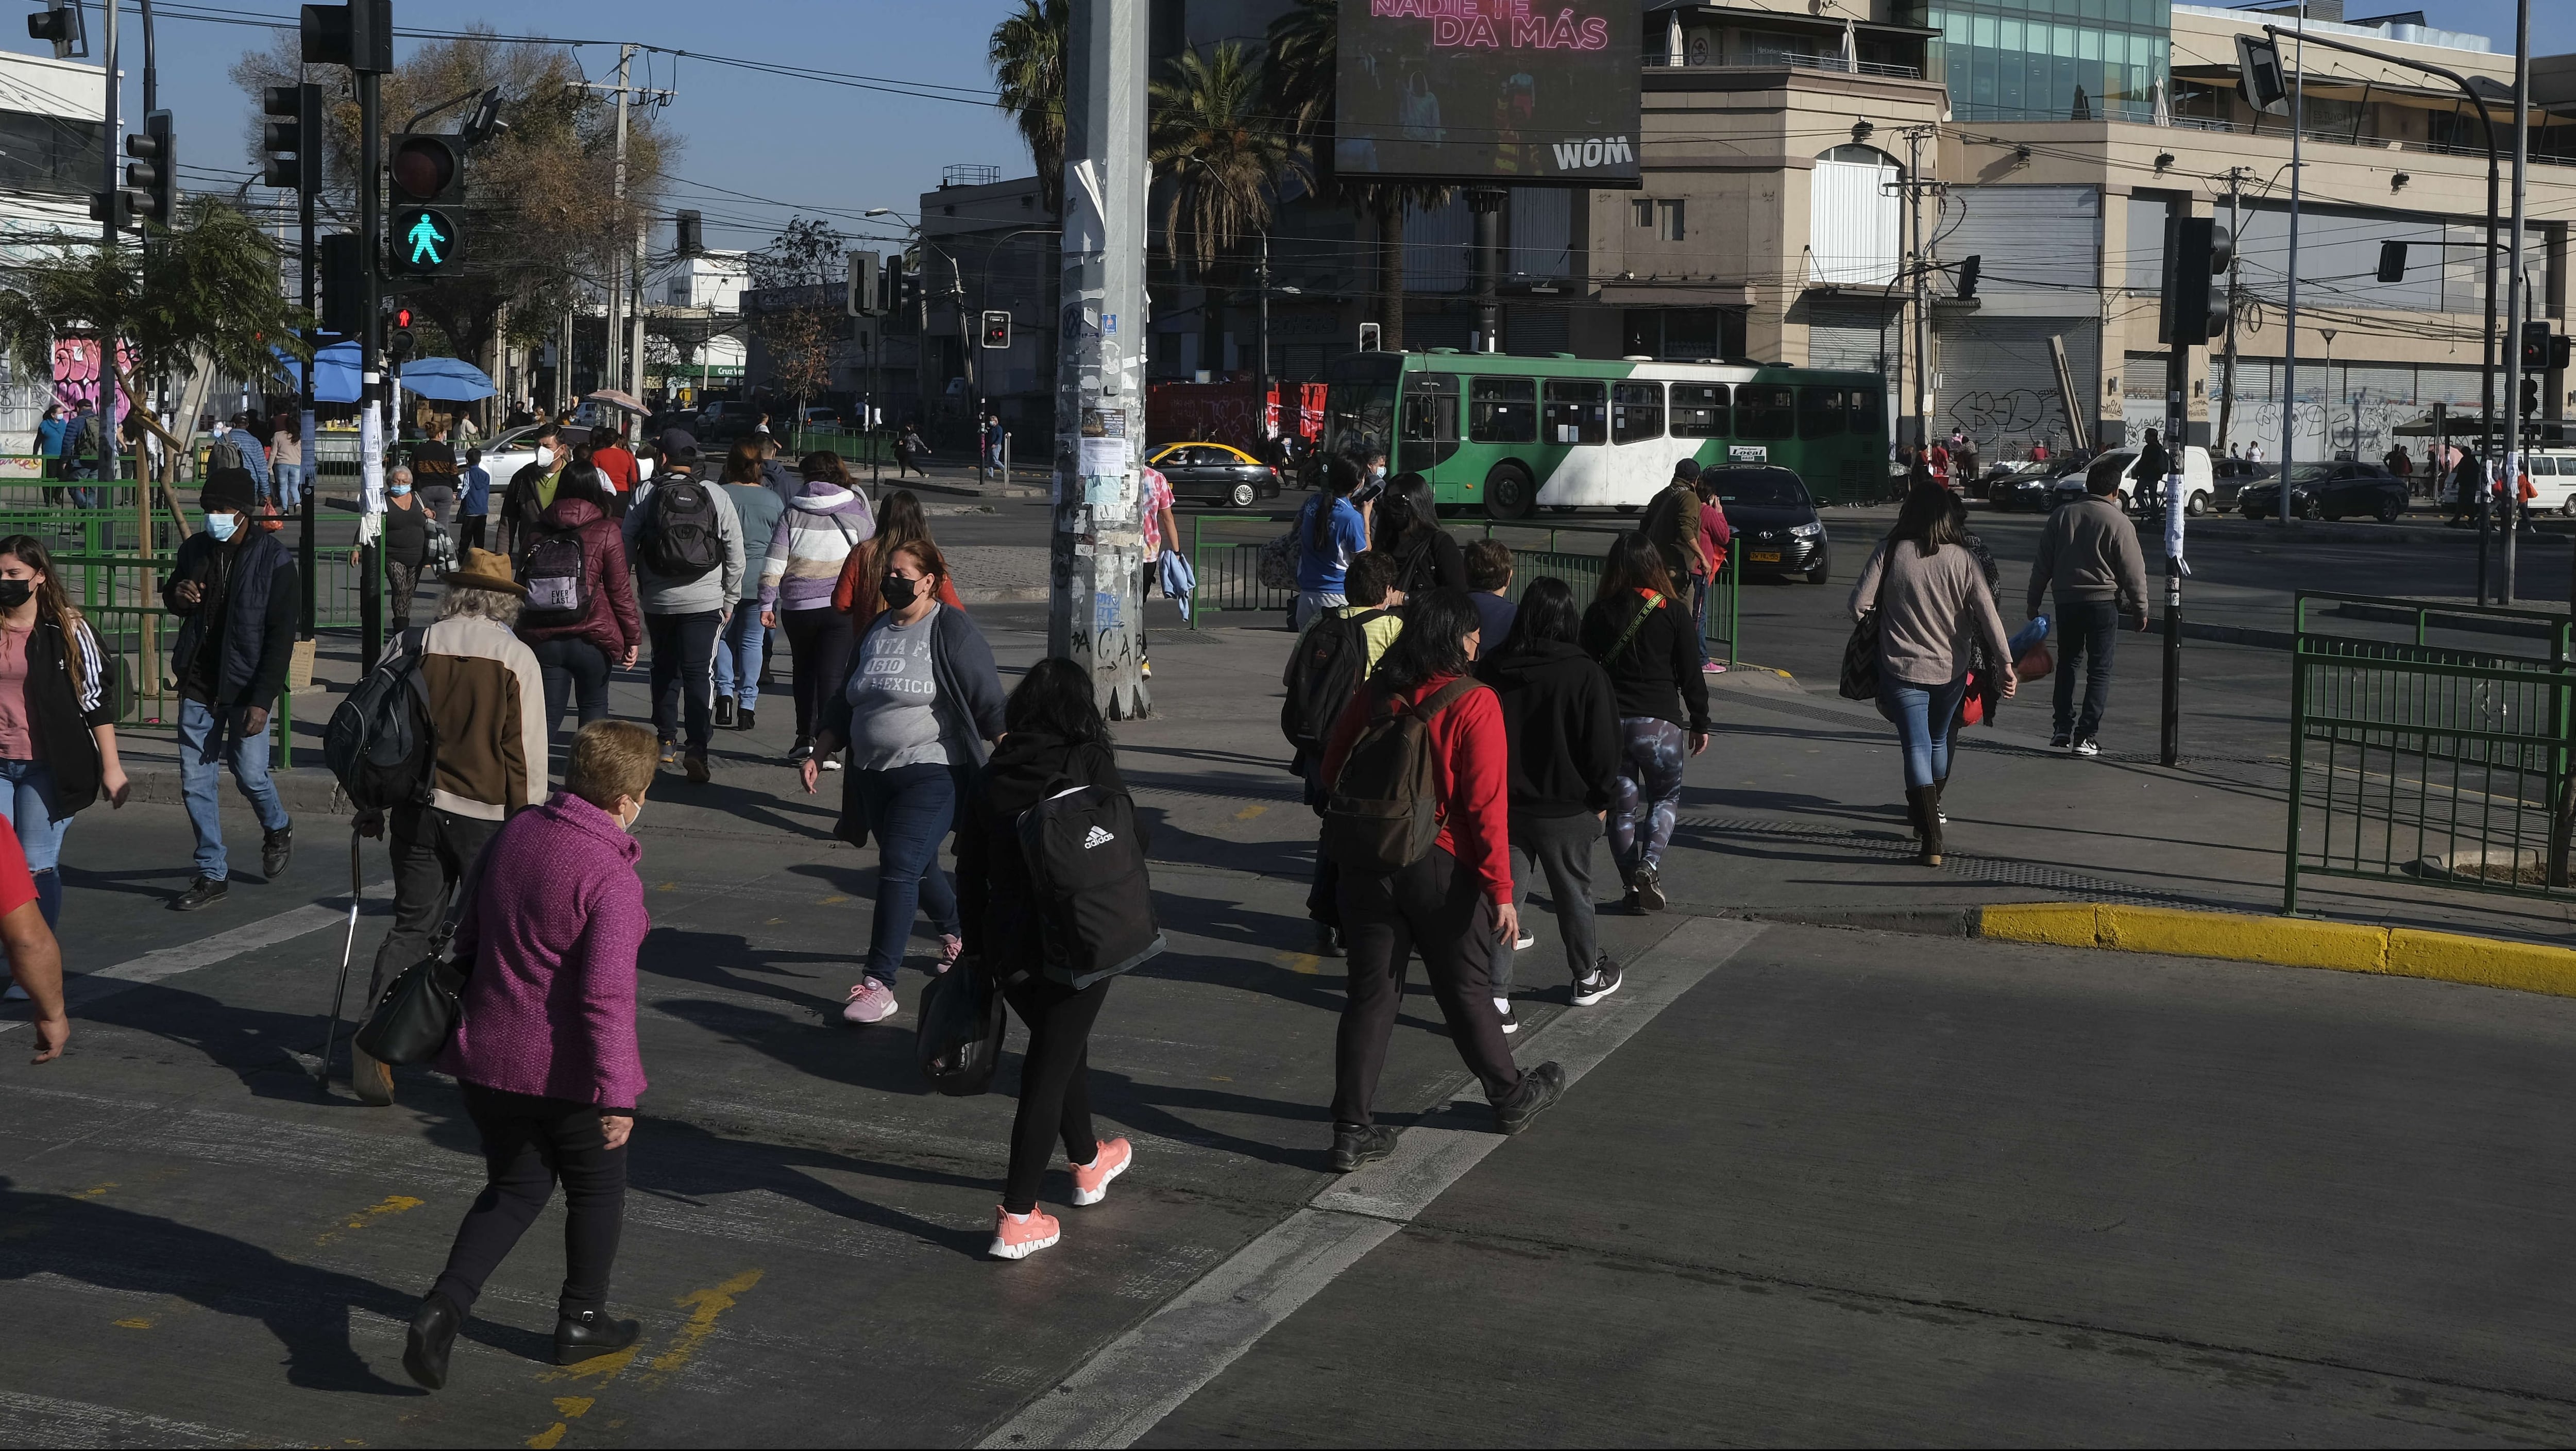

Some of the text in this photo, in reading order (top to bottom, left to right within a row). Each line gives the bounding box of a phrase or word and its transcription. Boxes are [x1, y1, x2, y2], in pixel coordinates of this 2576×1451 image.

[1434, 8, 1608, 50] DA MÁS
[1552, 136, 1633, 171] WOM
[1245, 314, 1340, 336] SECHERS
[867, 660, 901, 672] 1610
[870, 677, 934, 694] MEXICO
[1084, 832, 1114, 850] adidas
